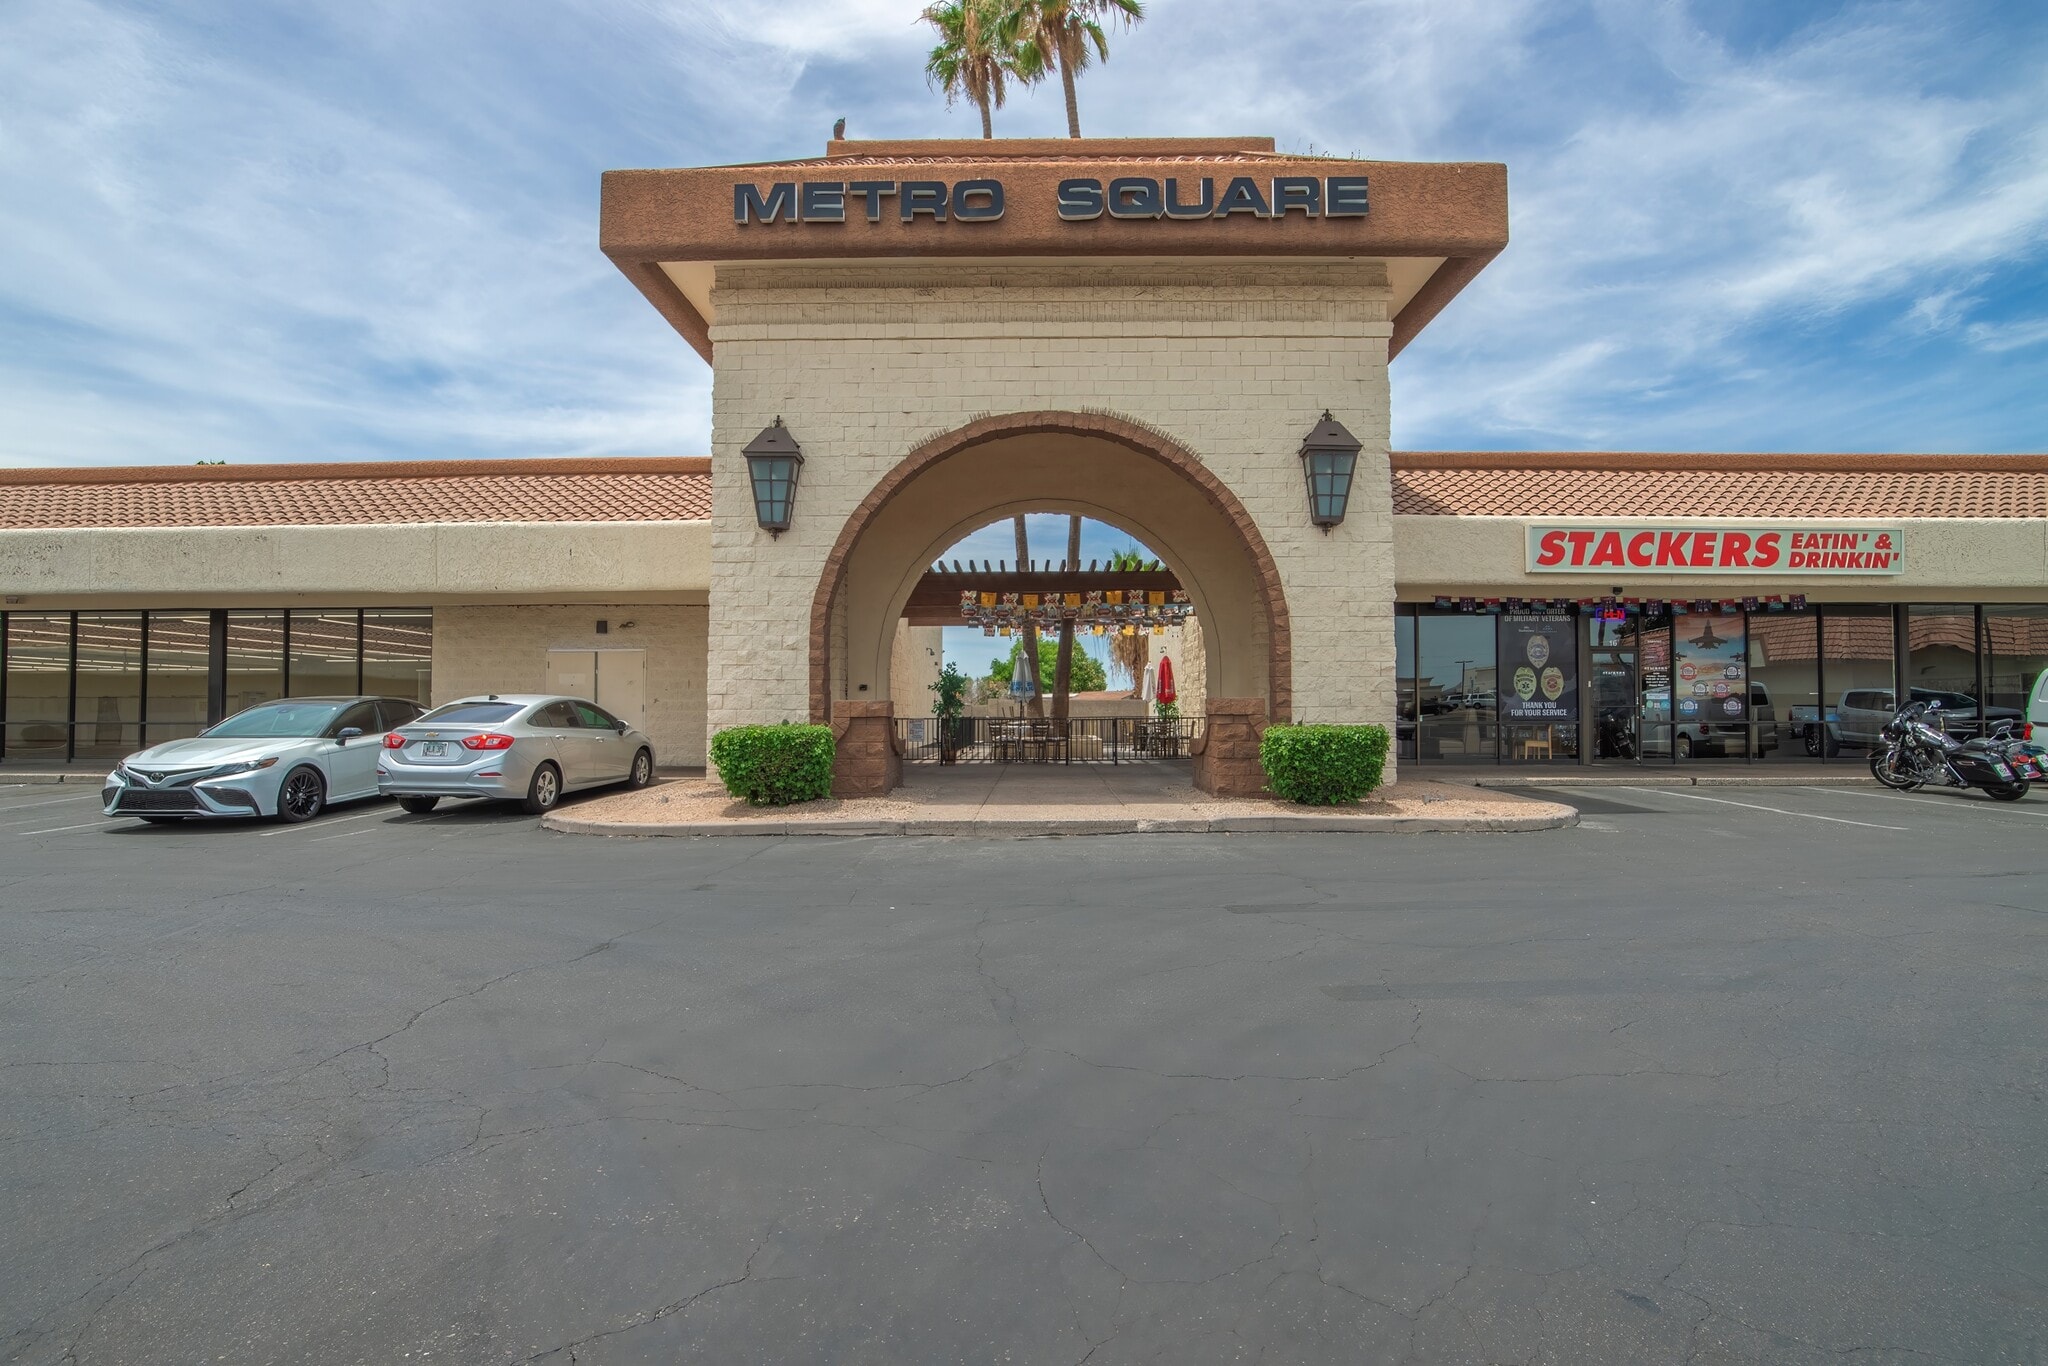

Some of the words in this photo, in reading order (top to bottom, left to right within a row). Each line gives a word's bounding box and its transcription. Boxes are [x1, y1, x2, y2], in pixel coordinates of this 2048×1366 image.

[734, 179, 1004, 225] METRO
[1057, 176, 1369, 220] SQUARE
[1536, 530, 1781, 568] STACKERS
[1790, 533, 1868, 550] EATIN'
[1874, 533, 1893, 550] &
[1788, 552, 1899, 569] DRINKIN'
[1522, 701, 1543, 709] THANK
